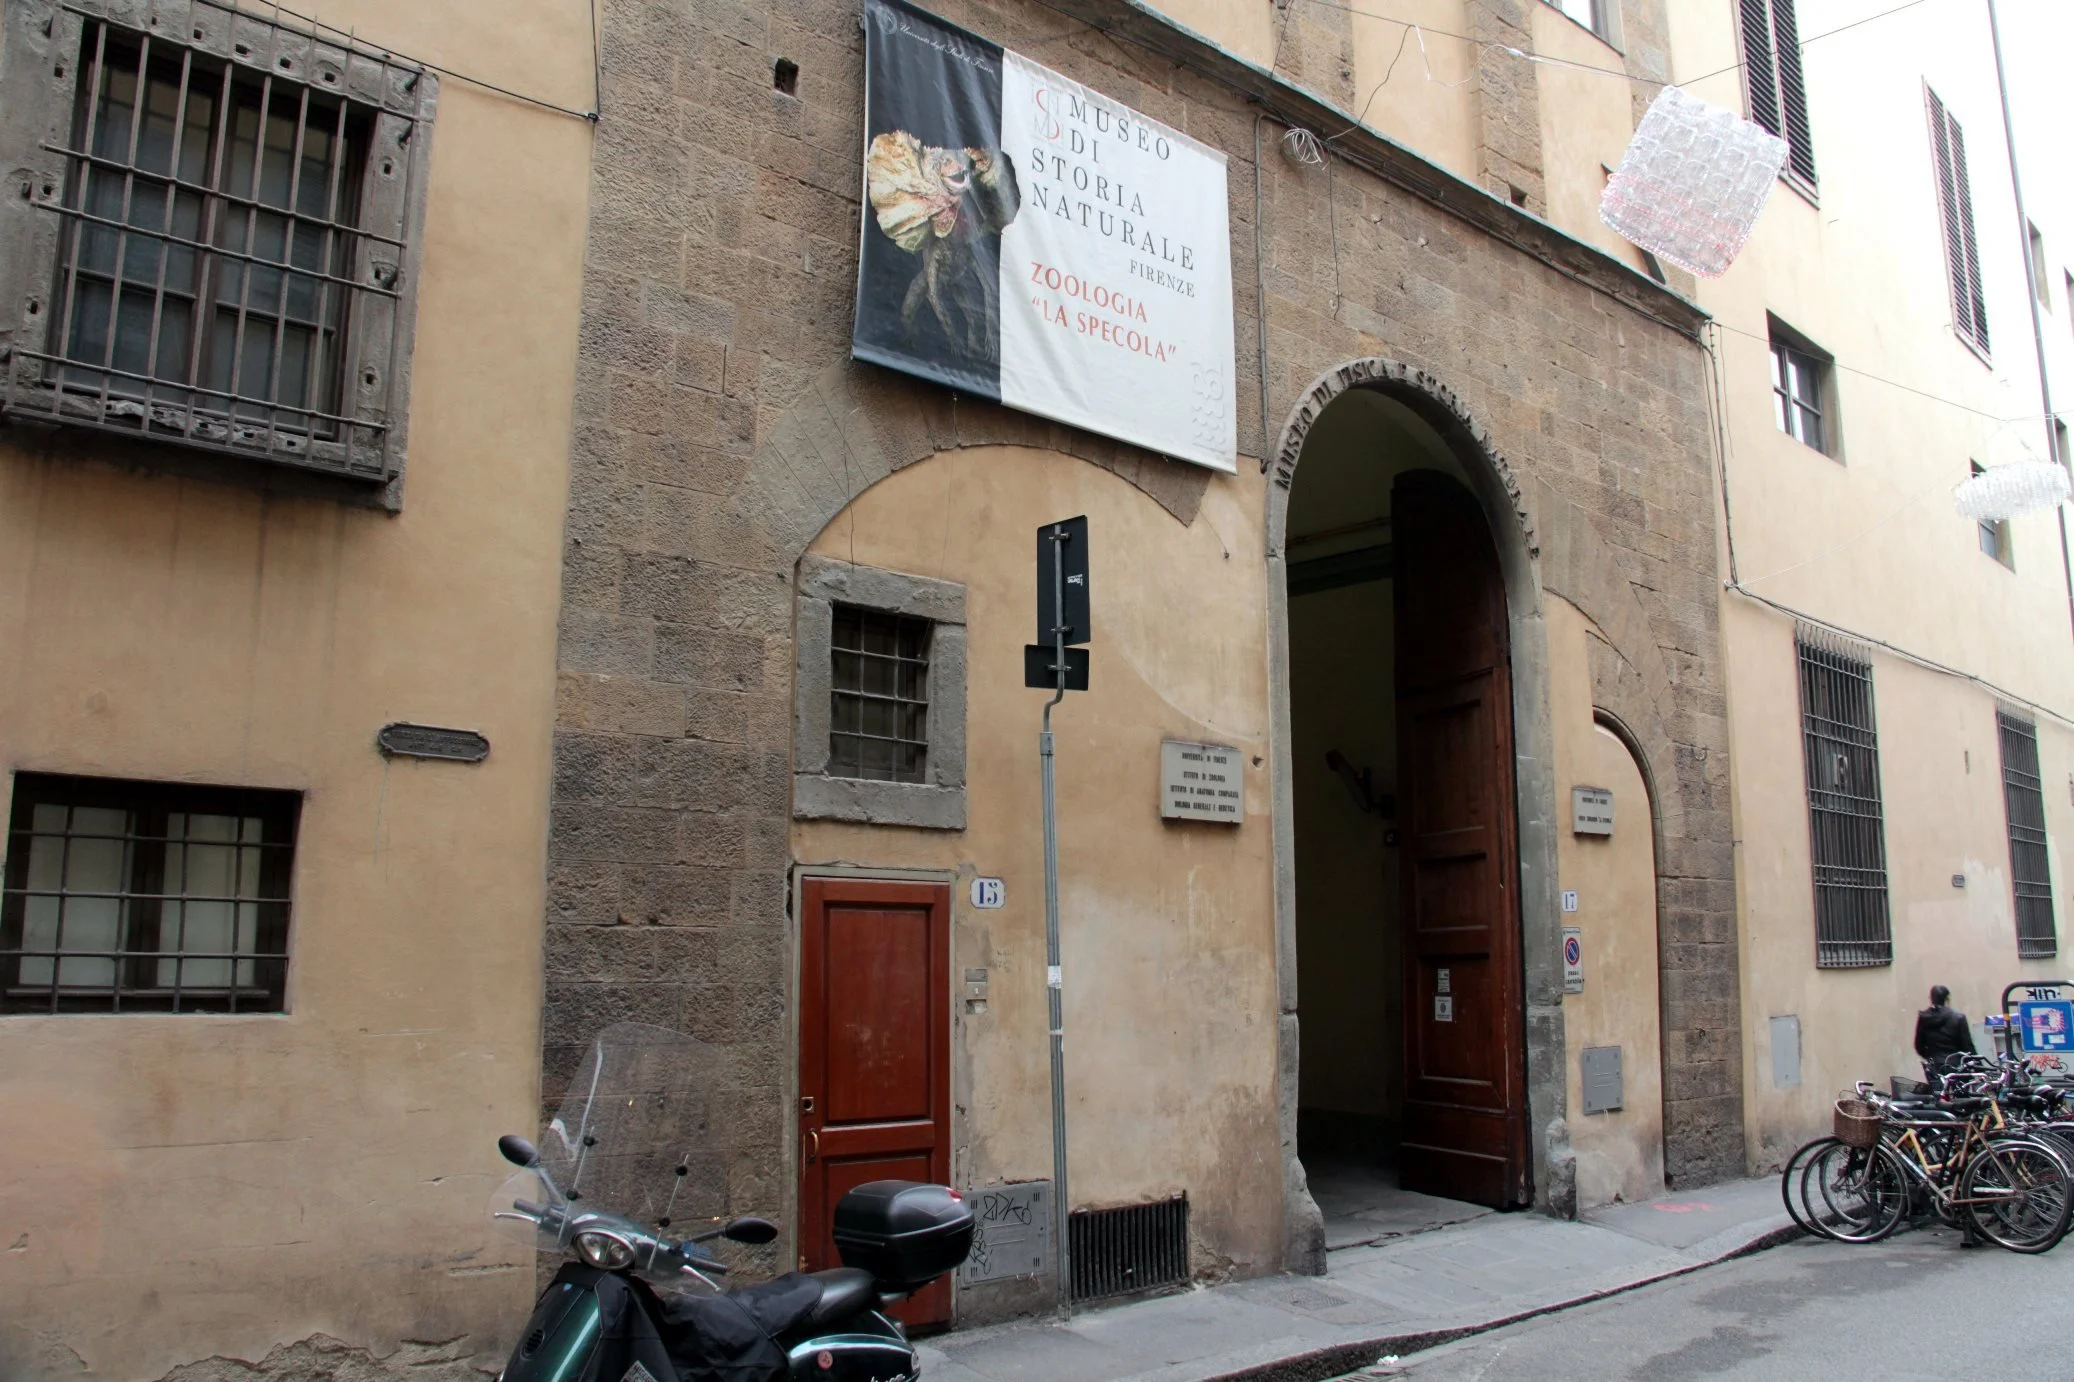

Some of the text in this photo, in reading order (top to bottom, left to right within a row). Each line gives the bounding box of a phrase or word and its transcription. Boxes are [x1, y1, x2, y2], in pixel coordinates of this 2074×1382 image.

[1069, 94, 1171, 162] MUSEO
[1069, 128, 1100, 164] DI
[1031, 147, 1146, 218] STORIA
[1031, 182, 1195, 272] NATURALE
[1031, 261, 1148, 324] ZOOLOGIA
[1130, 259, 1196, 299] FIRENZE
[1274, 406, 1313, 491] MUSEO
[979, 881, 998, 905] 15
[1564, 892, 1576, 909] 17
